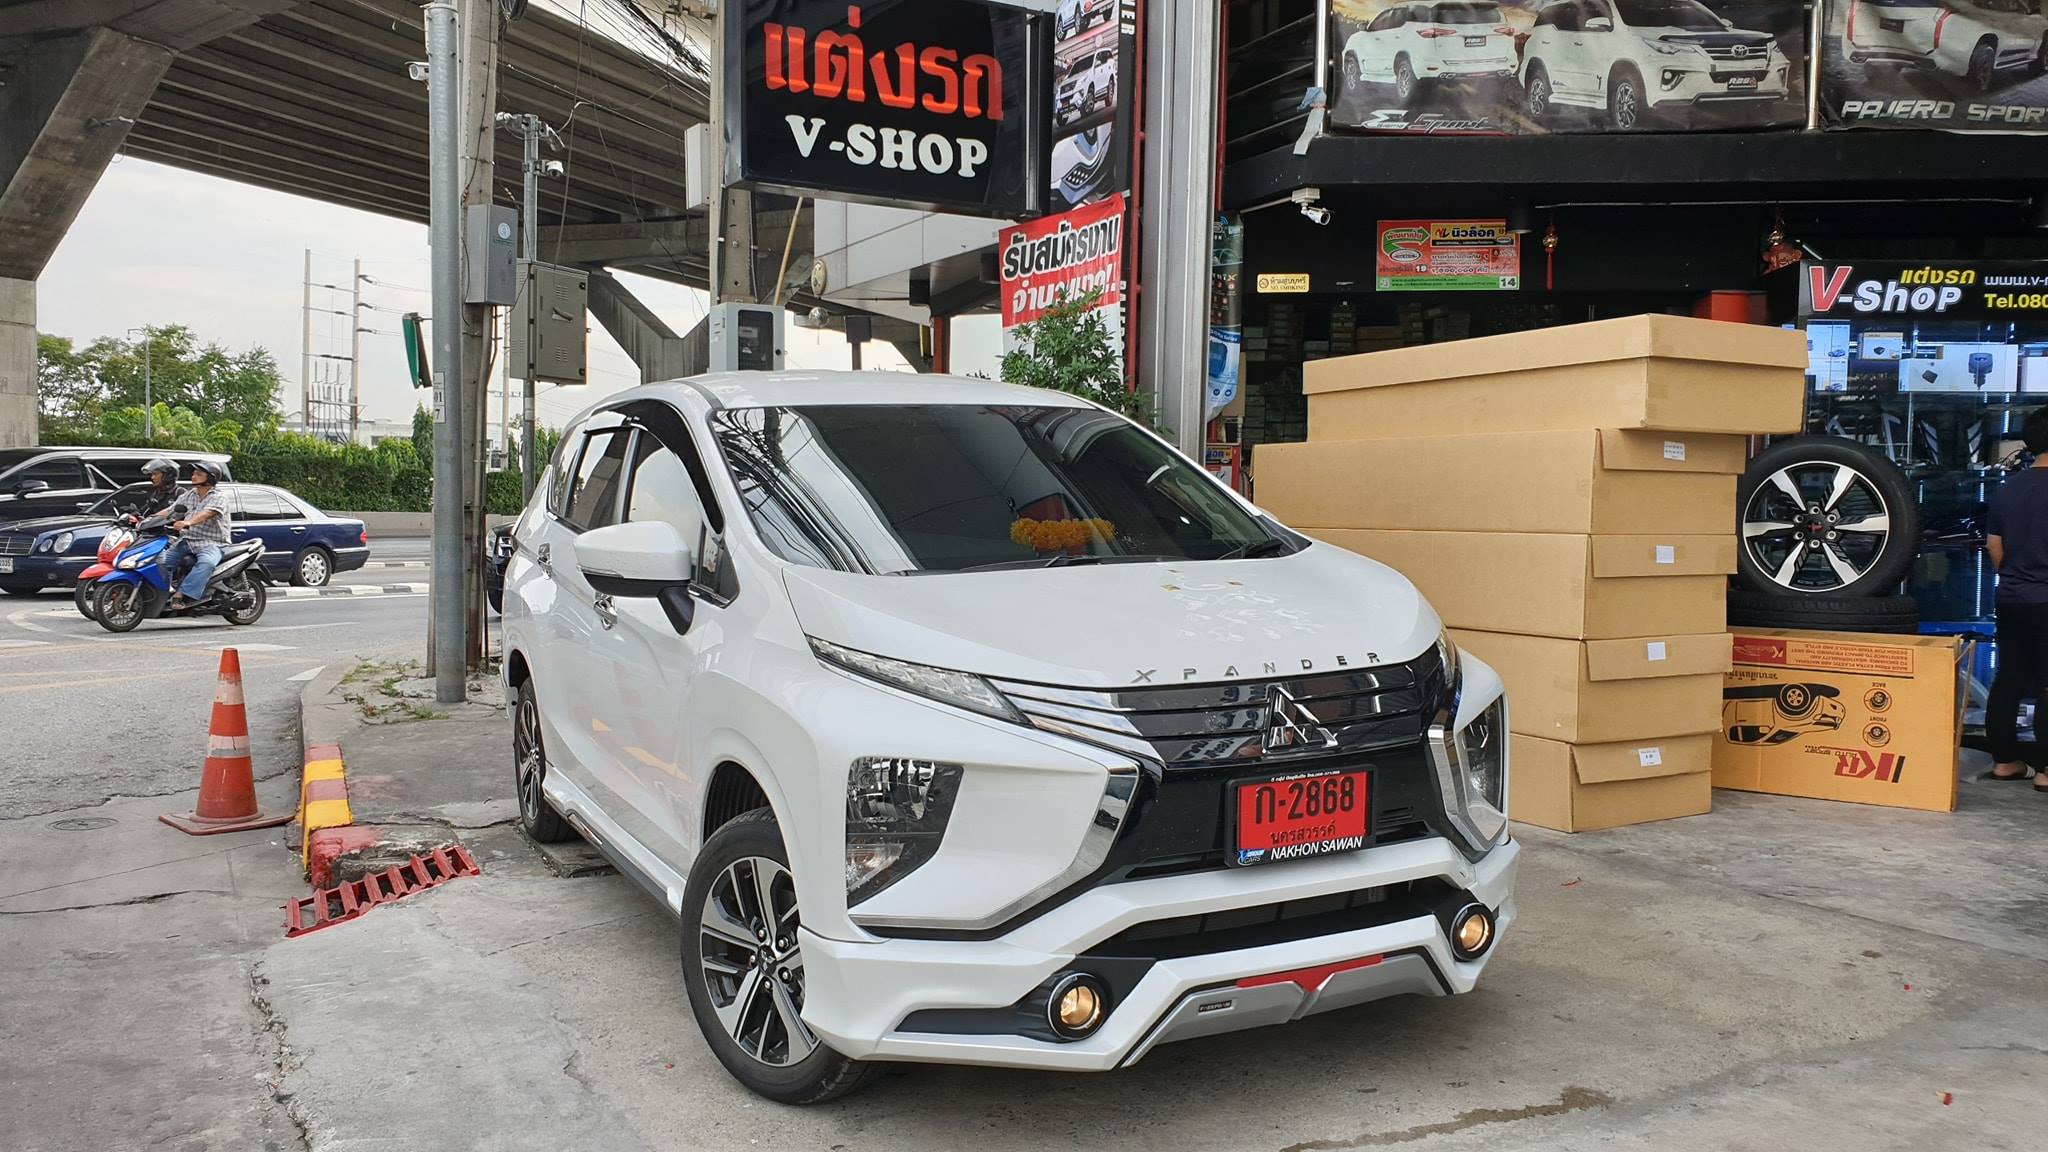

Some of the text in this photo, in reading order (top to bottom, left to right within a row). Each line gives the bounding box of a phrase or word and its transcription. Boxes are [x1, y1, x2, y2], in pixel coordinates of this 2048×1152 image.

[764, 5, 1005, 121] แต่งรถ
[1841, 100, 2048, 123] PAJERO SPOR
[785, 114, 988, 178] V-SHOP
[1003, 215, 1121, 280] รับสมัครงาน
[1500, 278, 1516, 287] 14
[1900, 266, 1976, 285] แต่งรถ
[1131, 652, 1381, 683] XPANDER
[1256, 776, 1354, 824] ก-2868
[1270, 820, 1336, 844] นครสวรรค์
[1270, 836, 1363, 861] NAKHON SAWAN
